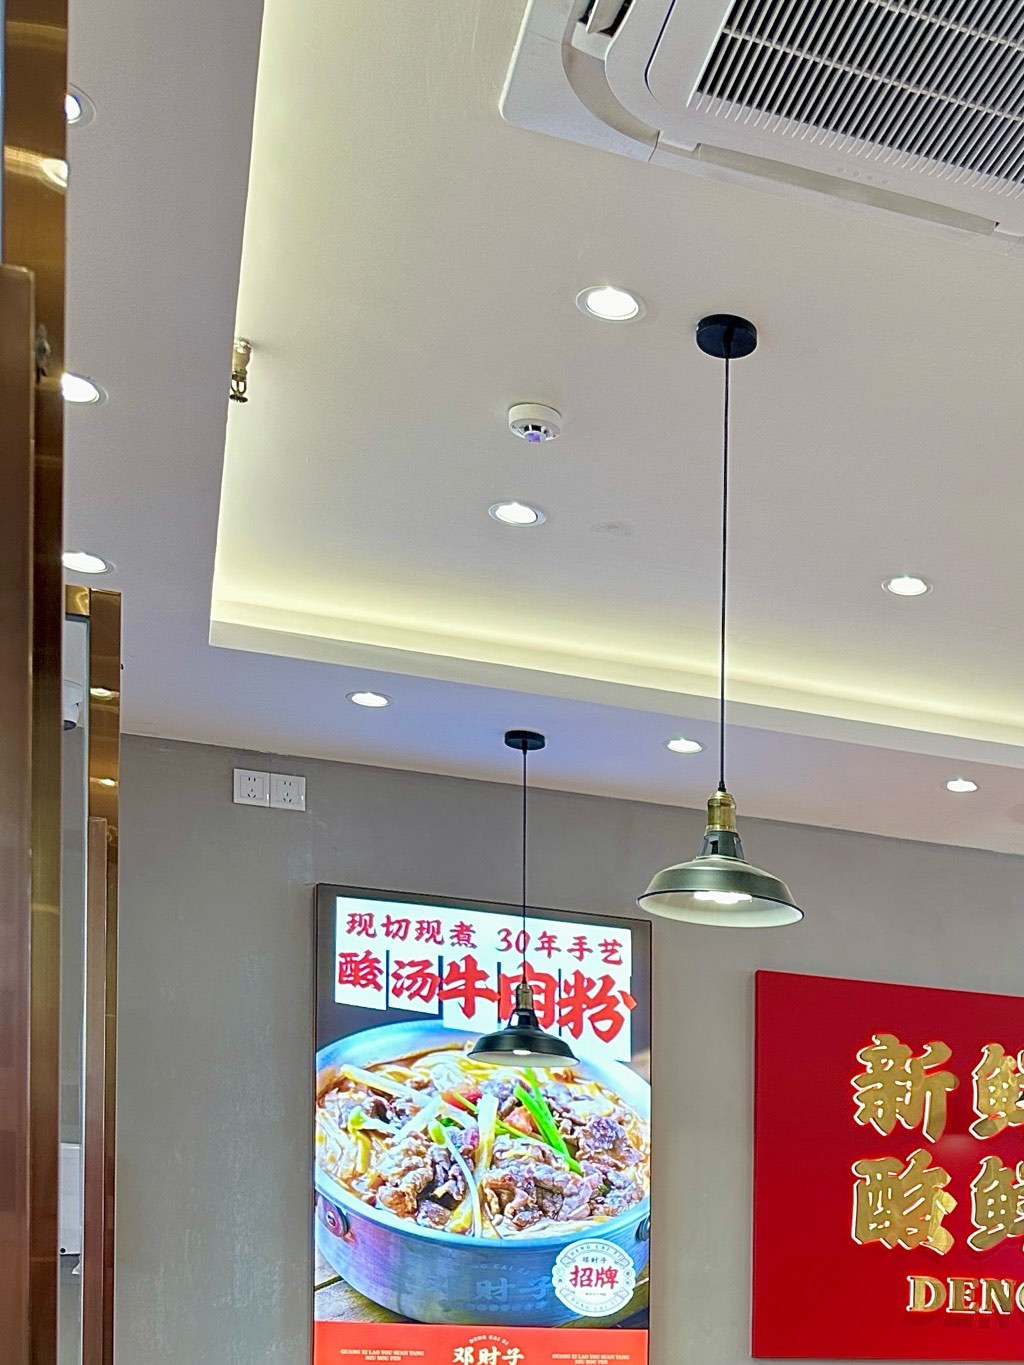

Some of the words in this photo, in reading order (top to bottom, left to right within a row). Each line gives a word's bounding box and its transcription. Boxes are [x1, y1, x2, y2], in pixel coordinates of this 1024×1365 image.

[345, 912, 478, 949] 现切现煮
[496, 927, 624, 966] 30年手艺
[338, 949, 639, 1044] 酸汤牛肉粉
[569, 1265, 619, 1289] 招牌
